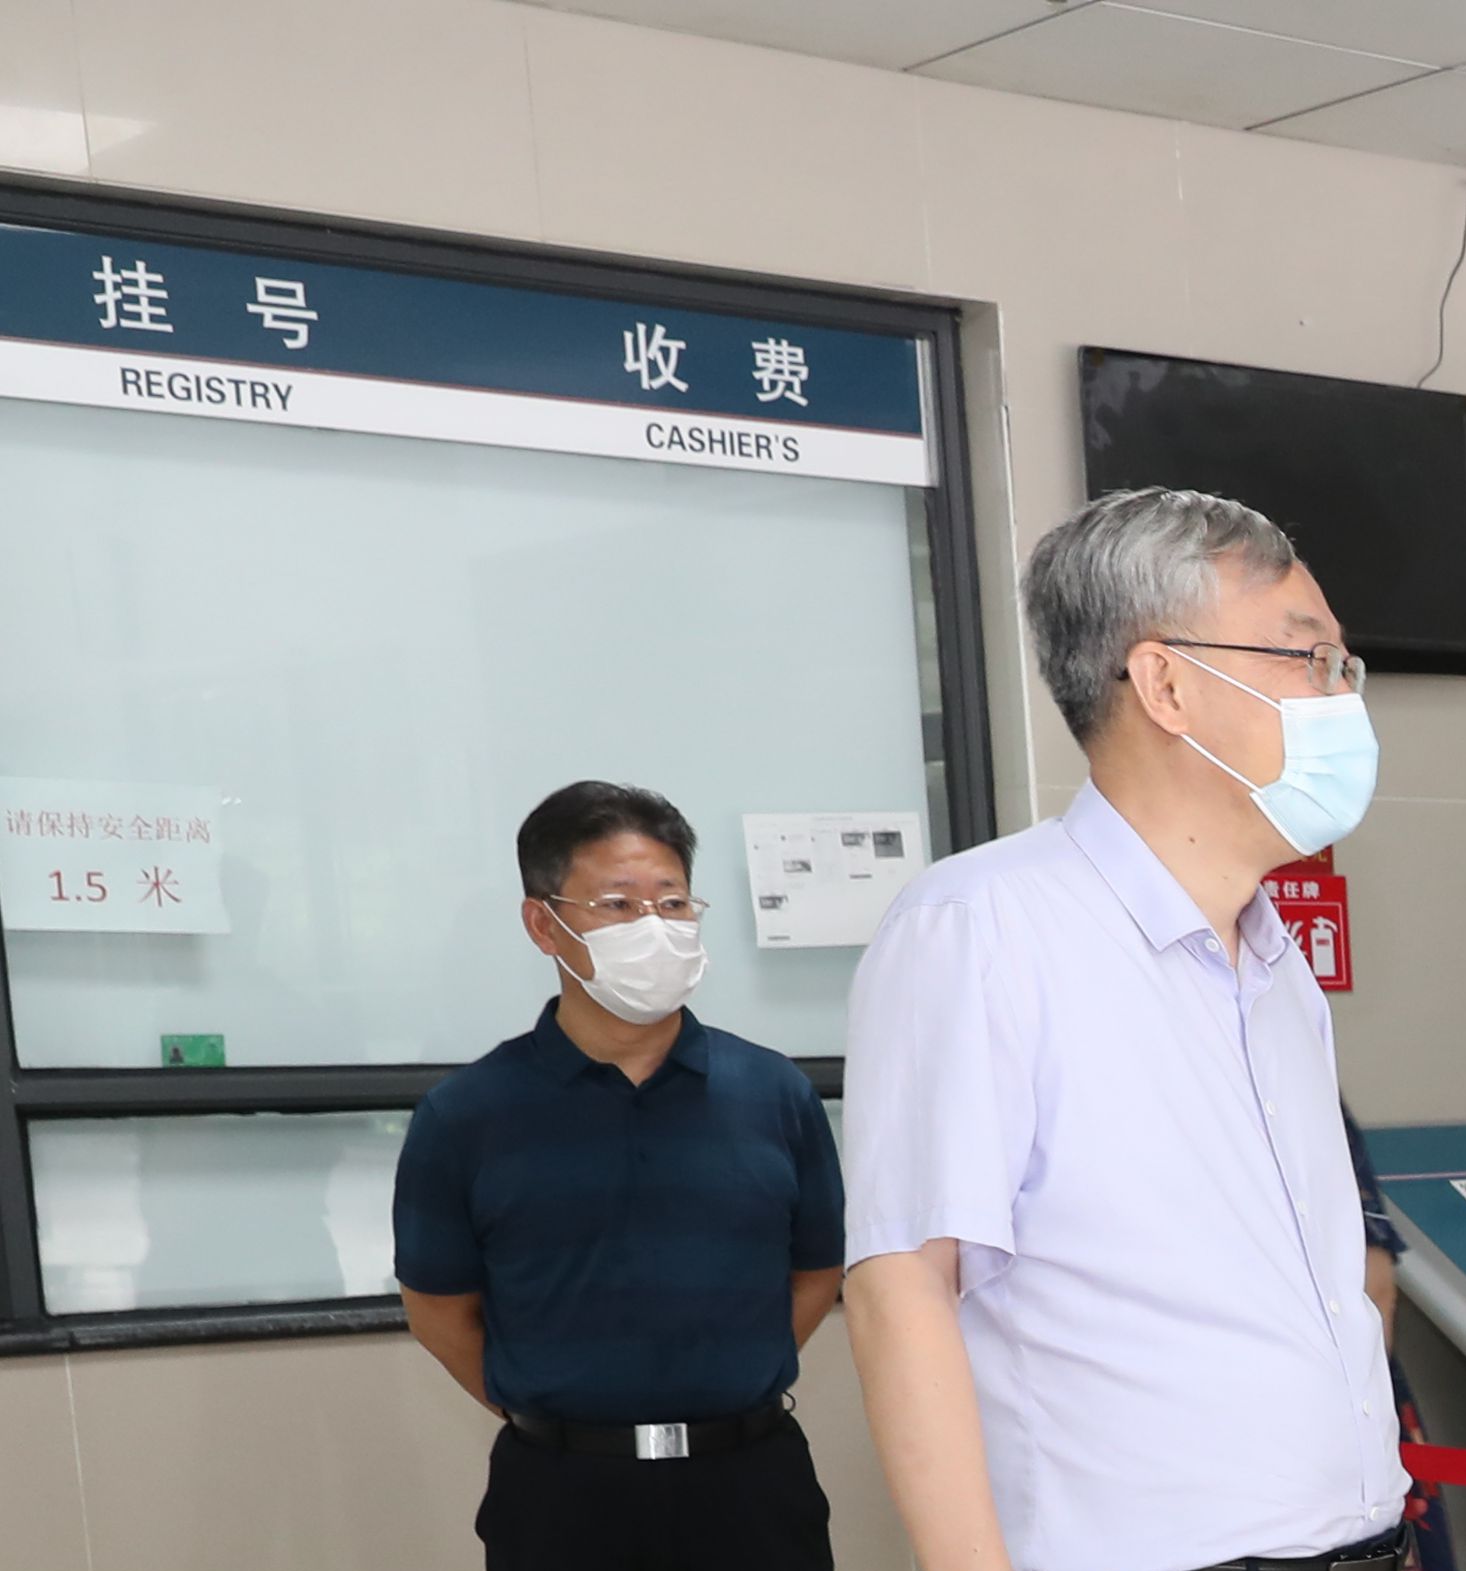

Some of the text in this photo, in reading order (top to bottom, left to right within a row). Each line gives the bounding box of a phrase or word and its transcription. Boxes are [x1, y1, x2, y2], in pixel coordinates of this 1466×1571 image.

[92, 254, 319, 350] 挂号
[622, 320, 811, 407] 收费
[118, 366, 295, 413] REGISTRY
[644, 421, 801, 463] CASHIER'S
[6, 810, 210, 843] 请保持安全距离
[48, 865, 181, 908] 1.5 米
